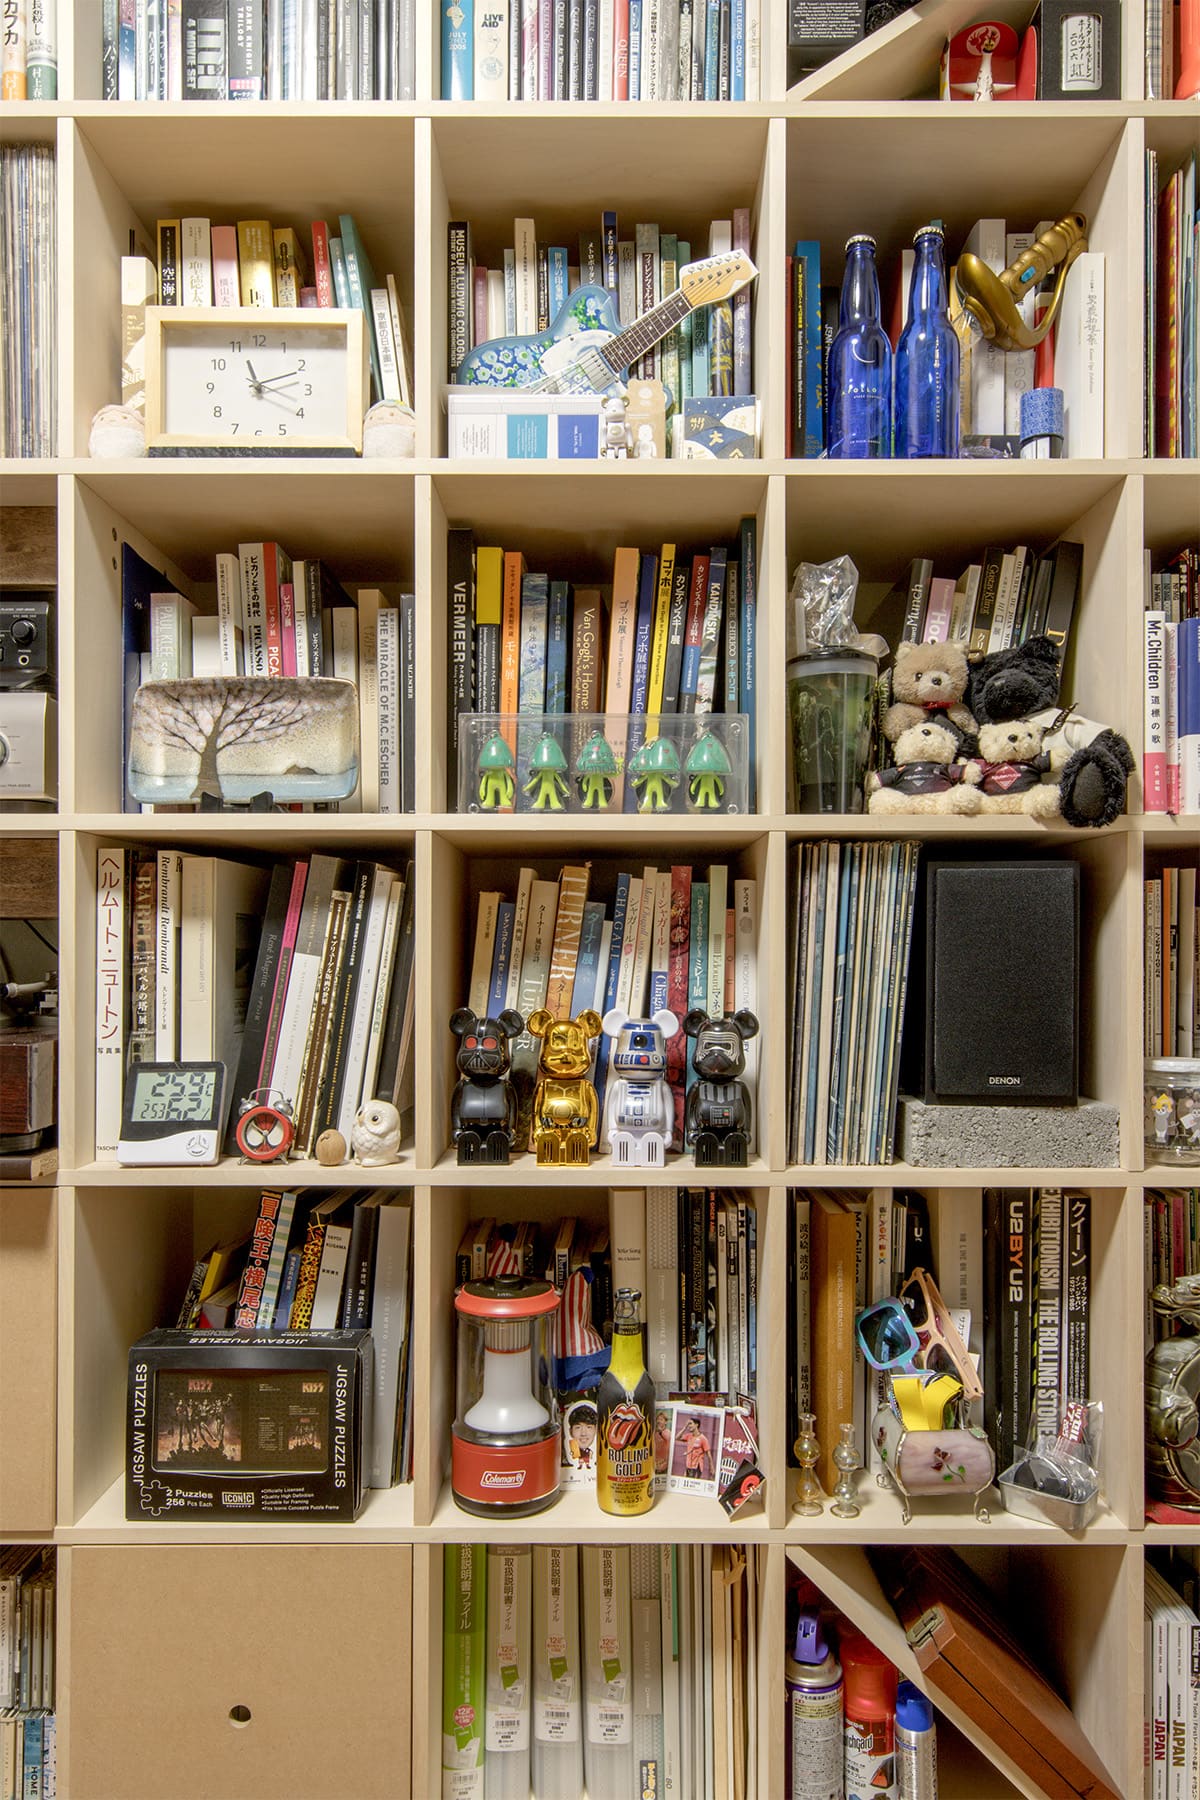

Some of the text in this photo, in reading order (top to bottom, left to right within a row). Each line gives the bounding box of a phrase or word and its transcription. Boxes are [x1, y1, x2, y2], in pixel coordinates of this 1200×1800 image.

[618, 39, 628, 78] QUEEN
[456, 230, 465, 367] MUSEUM LUDWIG COLOGNE
[230, 341, 242, 352] 11
[252, 335, 267, 347] 12
[281, 342, 287, 353] 1
[211, 359, 226, 371] 10
[298, 360, 306, 372] 2
[206, 382, 215, 394] 9
[304, 384, 312, 396] 3
[213, 406, 222, 418] 8
[231, 423, 239, 435] 7
[279, 424, 287, 436] 5
[295, 407, 305, 419] 4
[250, 555, 261, 617] ピカソとその時代
[906, 583, 923, 627] Munch
[453, 581, 466, 662] VERMEER
[617, 600, 629, 634] ゴッホ展
[705, 582, 721, 642] KANDINSKY
[253, 624, 264, 671] PICASSO
[636, 624, 650, 663] ゴッホ展
[728, 620, 736, 656] CHIRICO
[1147, 619, 1162, 689] Mr.Children
[268, 646, 280, 677] PICA
[504, 641, 517, 681] モネ展
[579, 607, 595, 710] Van Gogh's Home:
[379, 611, 389, 786] THE MIRACLE OF M.C. ESCHER
[1151, 695, 1161, 744] 道標の歌
[160, 856, 171, 974] Rembrandt Rembrandt
[550, 872, 588, 980] TURNER
[610, 887, 628, 960] CHAGALL
[624, 898, 639, 944] シャガール
[656, 899, 668, 946] シャガール
[101, 856, 120, 1040] ヘルムート・ニュートン
[581, 912, 600, 966] ターナー展
[259, 955, 275, 988] Magritte
[653, 974, 668, 1012] Chaga
[97, 1047, 121, 1055] 写真集
[989, 1076, 1021, 1085] DENON
[879, 1206, 888, 1241] BLACK
[1039, 1187, 1062, 1290] EXHIBITIONISM
[1071, 1201, 1087, 1267] クイーン
[1039, 1298, 1059, 1325] THE
[1038, 1326, 1059, 1387] ROLLING
[188, 1379, 213, 1391] KISS
[302, 1382, 324, 1393] KISS
[133, 1363, 148, 1487] JIGSAW PUZZLES
[334, 1364, 348, 1489] JIGSAW PUZZLES
[608, 1448, 649, 1462] ROLLING
[615, 1463, 642, 1477] GOLD
[166, 1489, 214, 1499] 2 Puzzles
[484, 1473, 522, 1486] Coleman
[503, 1557, 514, 1631] 取扱説明書ファイル
[551, 1549, 561, 1622] 取扱説明書ファイル
[603, 1550, 613, 1623] 取扱説明書ファイル
[1154, 1719, 1166, 1761] JAPAN
[1172, 1720, 1186, 1767] JAPAN
[30, 1766, 38, 1796] HOME
